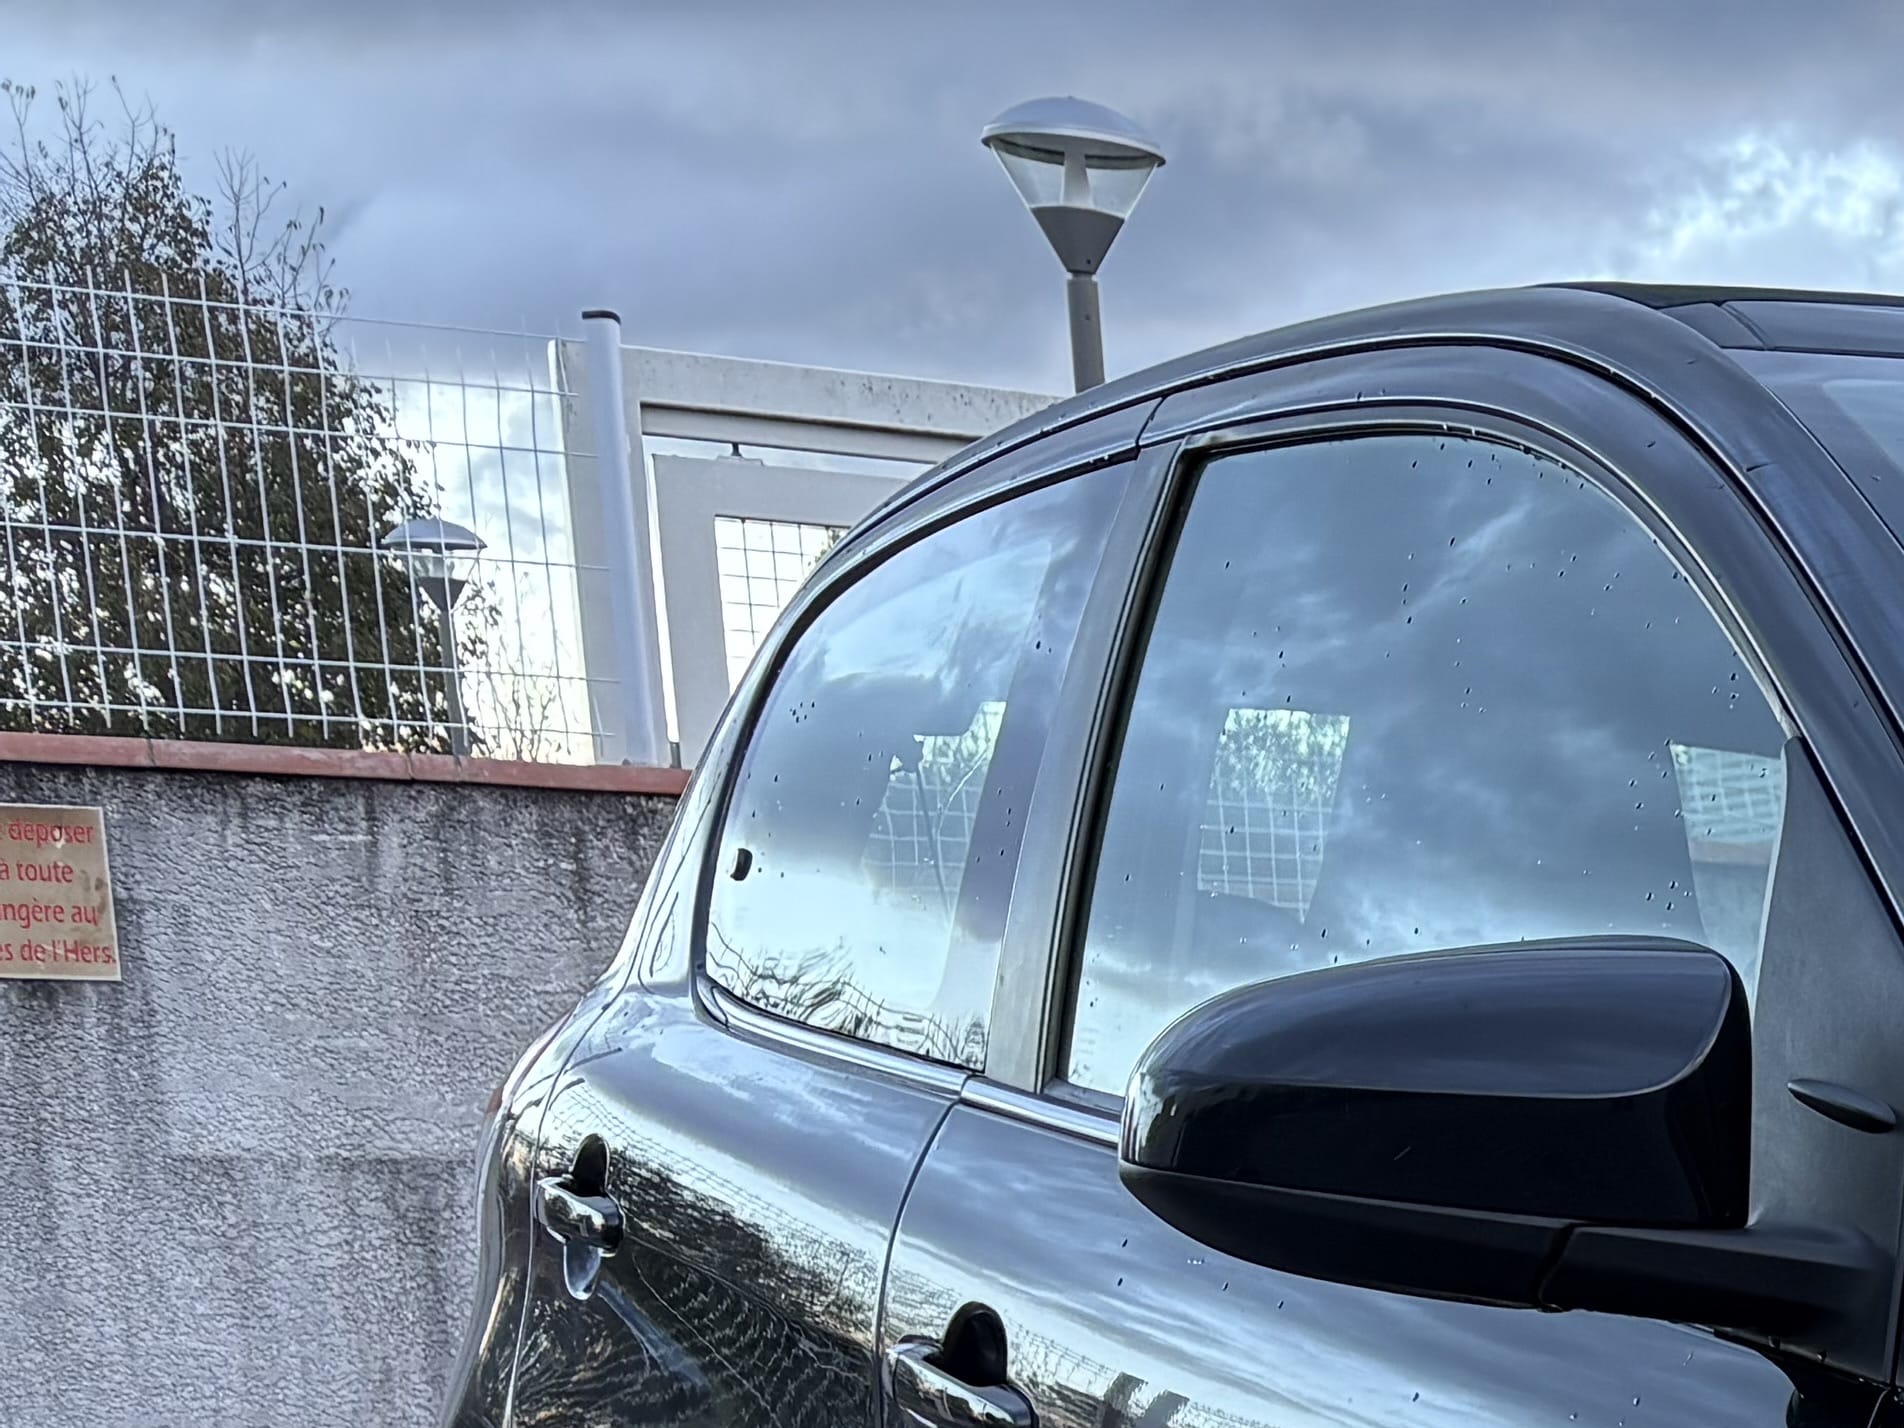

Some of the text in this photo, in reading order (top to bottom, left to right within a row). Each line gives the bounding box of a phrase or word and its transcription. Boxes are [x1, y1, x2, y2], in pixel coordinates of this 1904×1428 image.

[16, 861, 74, 884] toute
[0, 898, 99, 929] ngère au
[20, 938, 46, 963] de
